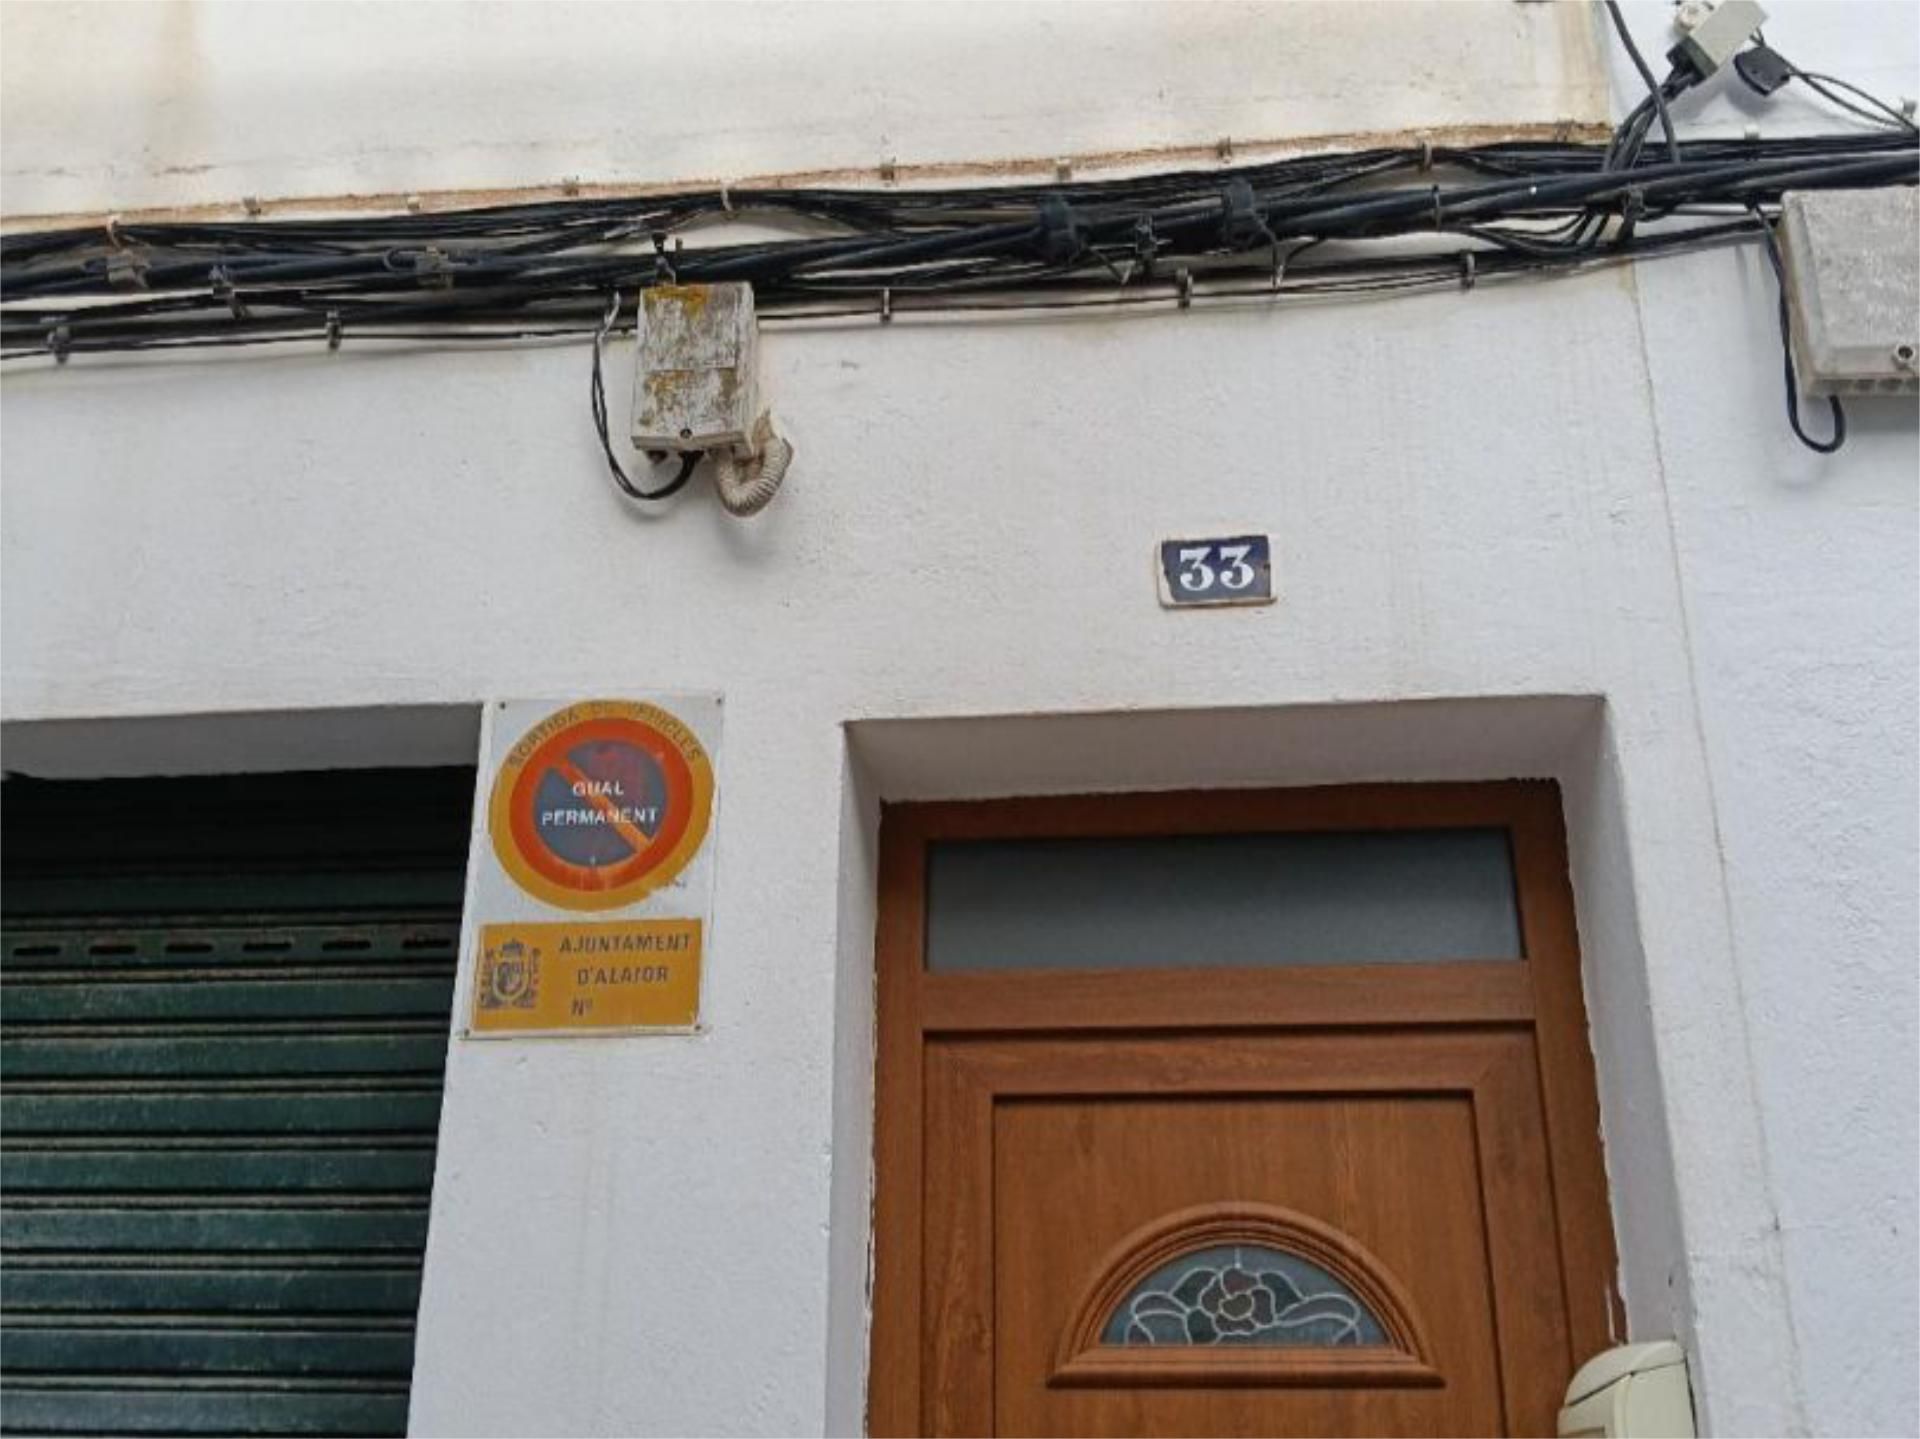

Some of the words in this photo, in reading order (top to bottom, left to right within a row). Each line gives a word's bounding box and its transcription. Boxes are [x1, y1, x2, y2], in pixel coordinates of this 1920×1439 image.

[1180, 545, 1255, 591] 33
[572, 781, 624, 798] GUAL
[541, 807, 659, 827] PERMANENT
[559, 933, 691, 953] AJUNTAMENT
[577, 966, 669, 986] D'ALAIOR
